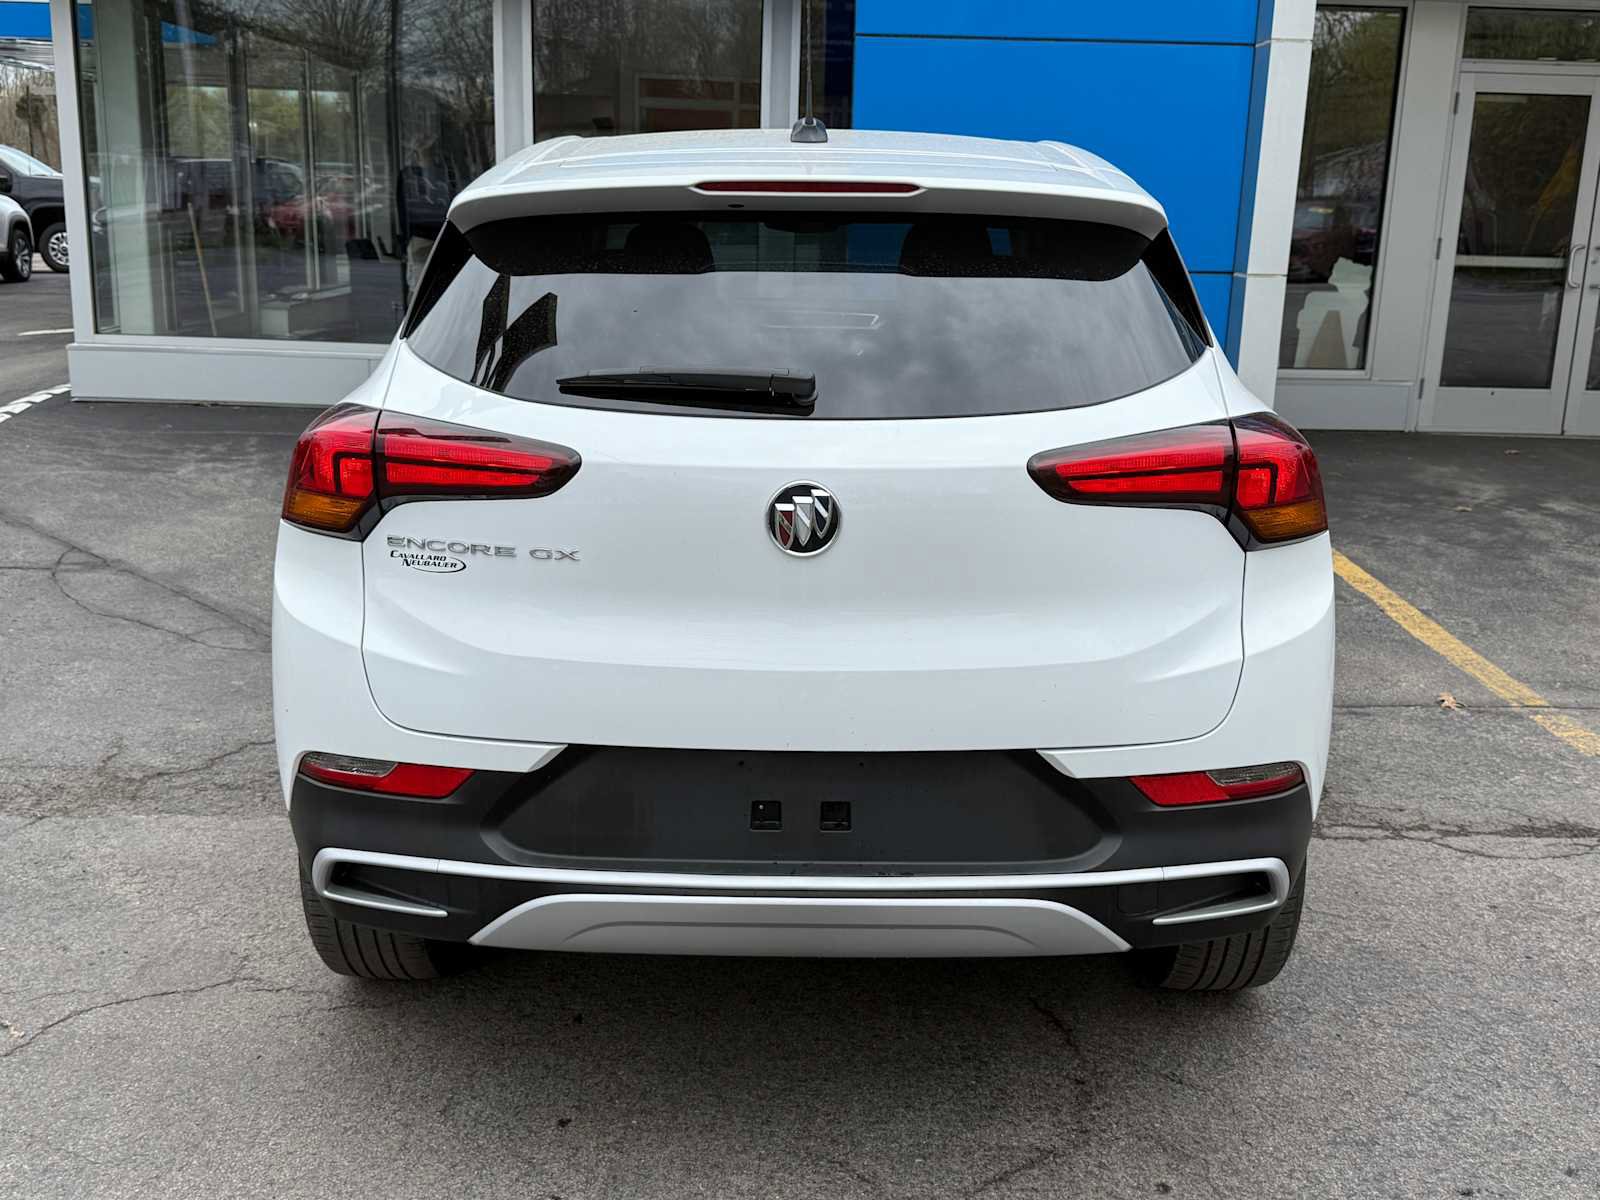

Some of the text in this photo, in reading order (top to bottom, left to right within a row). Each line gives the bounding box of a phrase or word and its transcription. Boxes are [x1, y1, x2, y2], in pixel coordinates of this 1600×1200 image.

[386, 535, 581, 562] ENCORE GX
[390, 549, 447, 562] CAVALLARO
[401, 558, 458, 569] NEUBAUER
